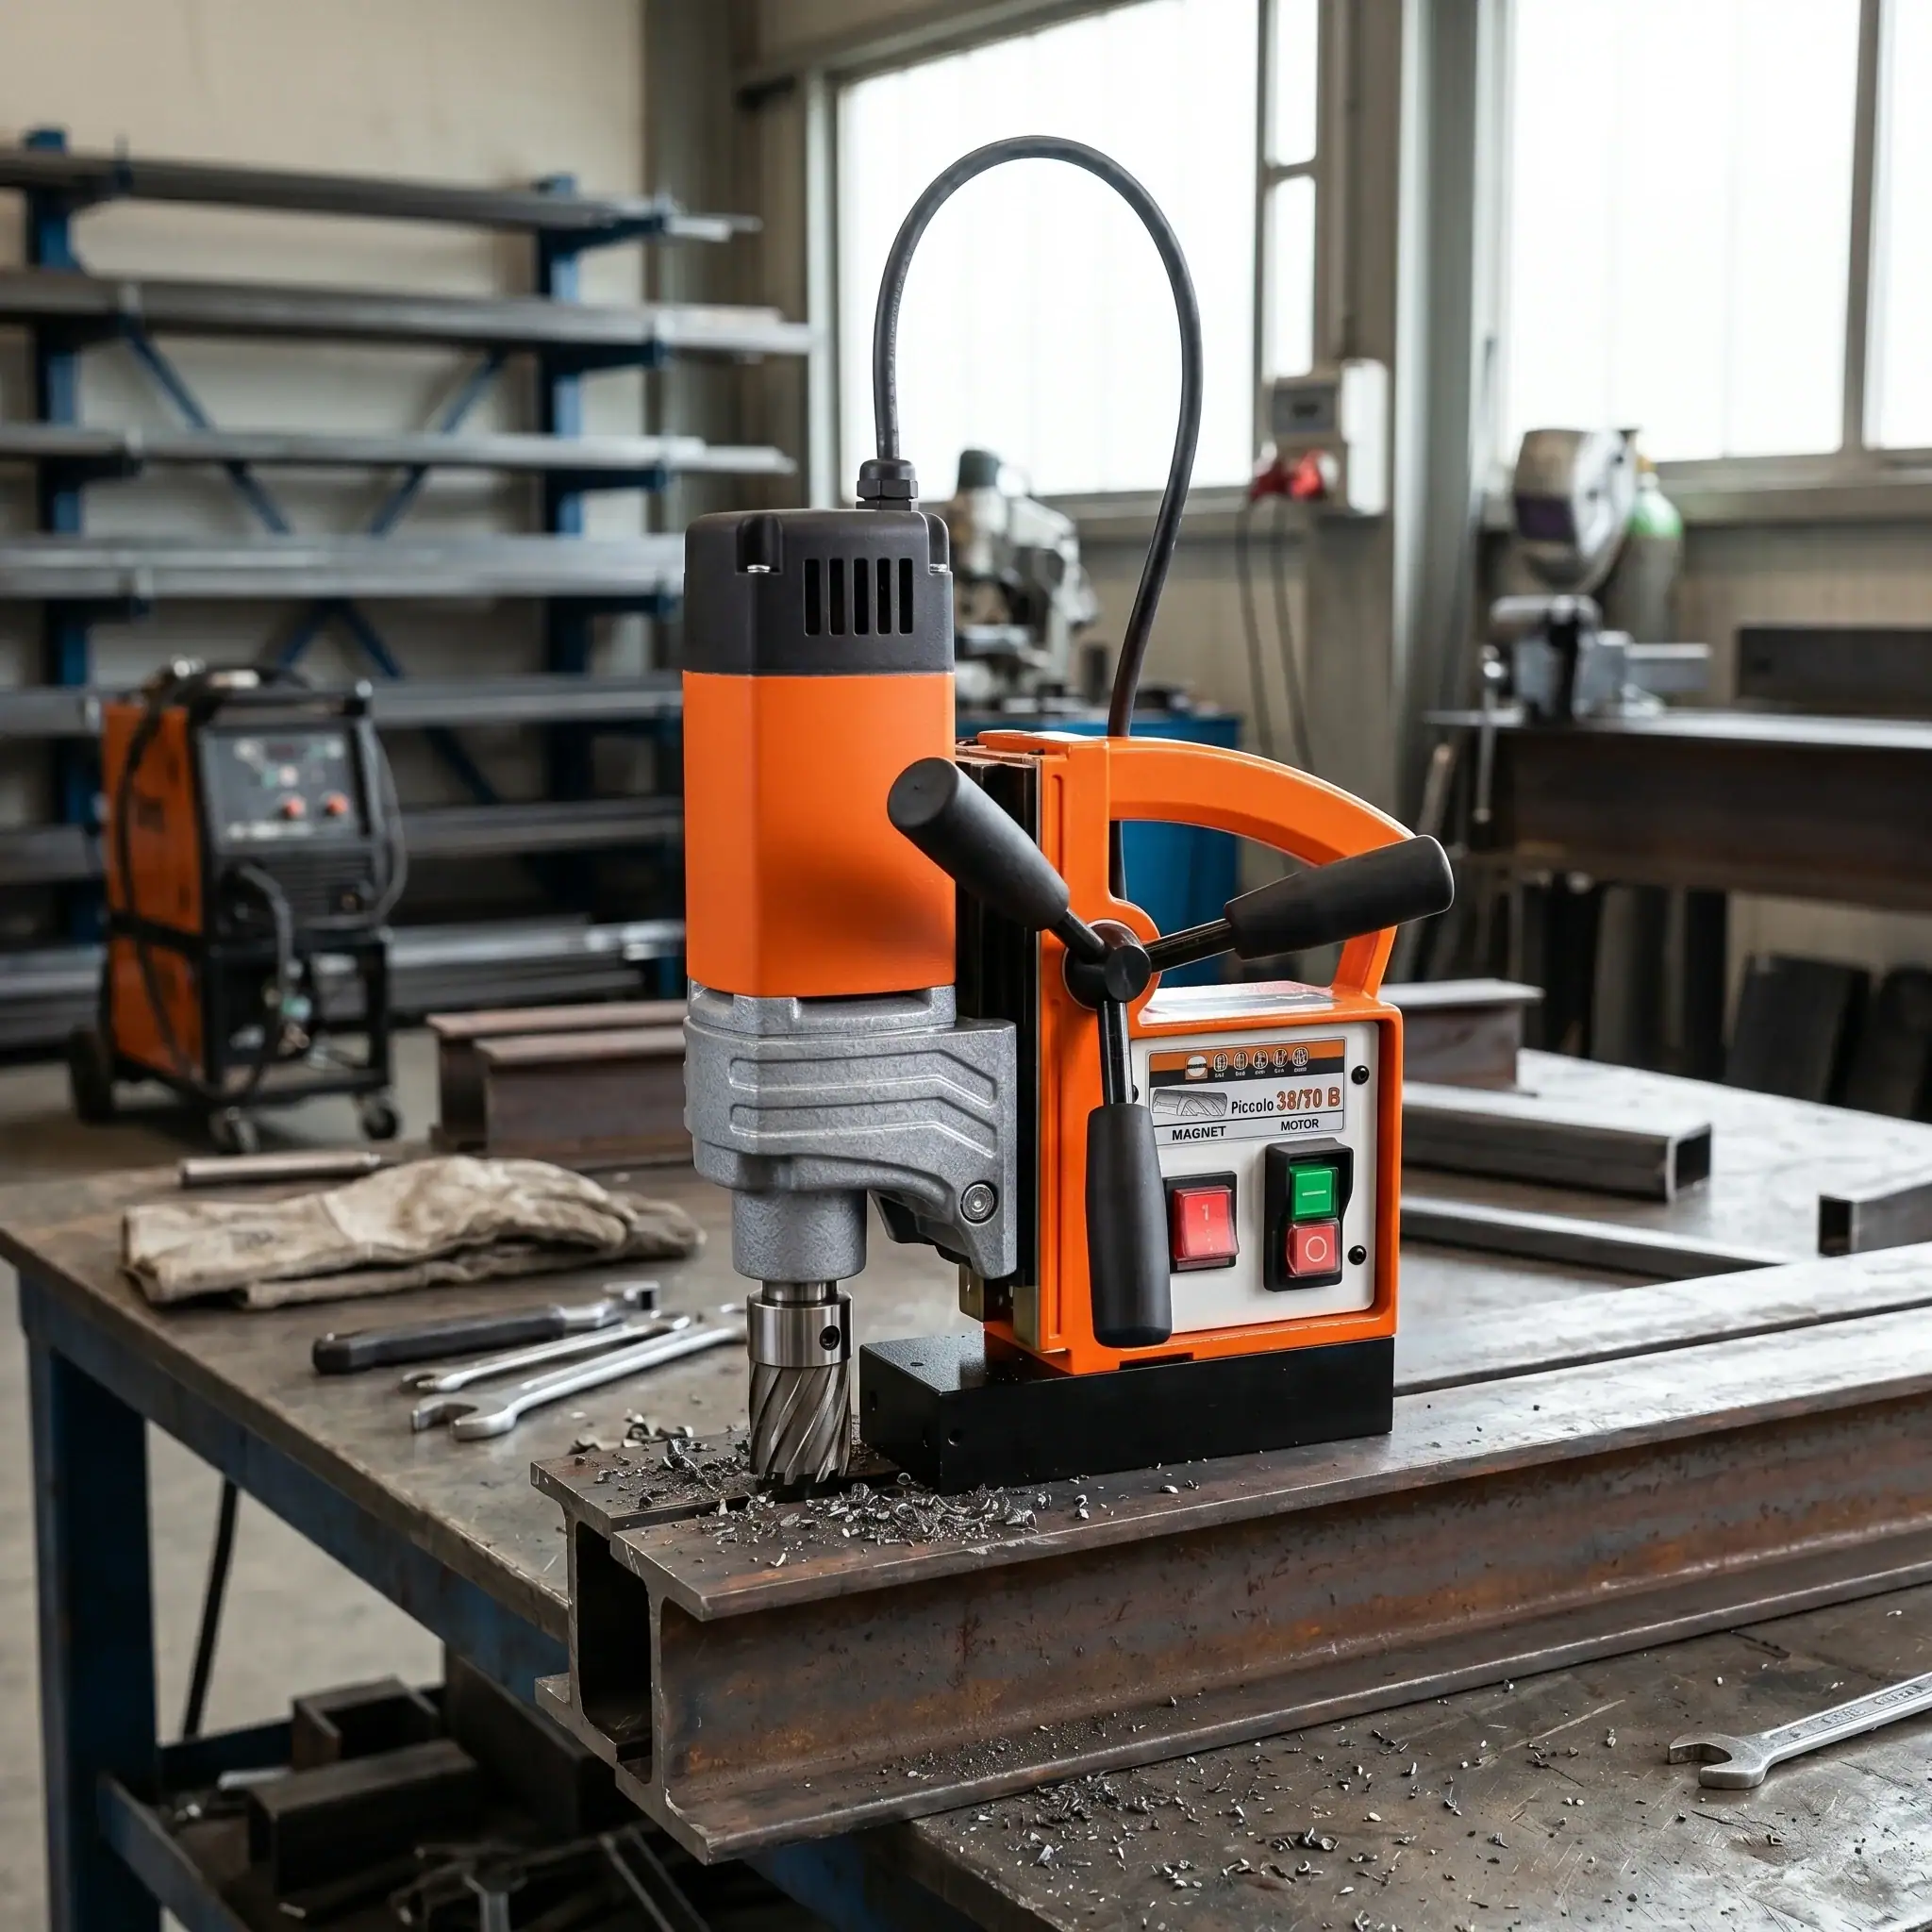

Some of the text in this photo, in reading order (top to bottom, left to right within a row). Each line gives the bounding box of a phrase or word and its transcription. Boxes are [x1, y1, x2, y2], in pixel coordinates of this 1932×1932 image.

[1231, 1098, 1274, 1114] Piccolo
[1327, 1087, 1341, 1107] B
[1172, 1119, 1319, 1141] MAGNET MOTOR
